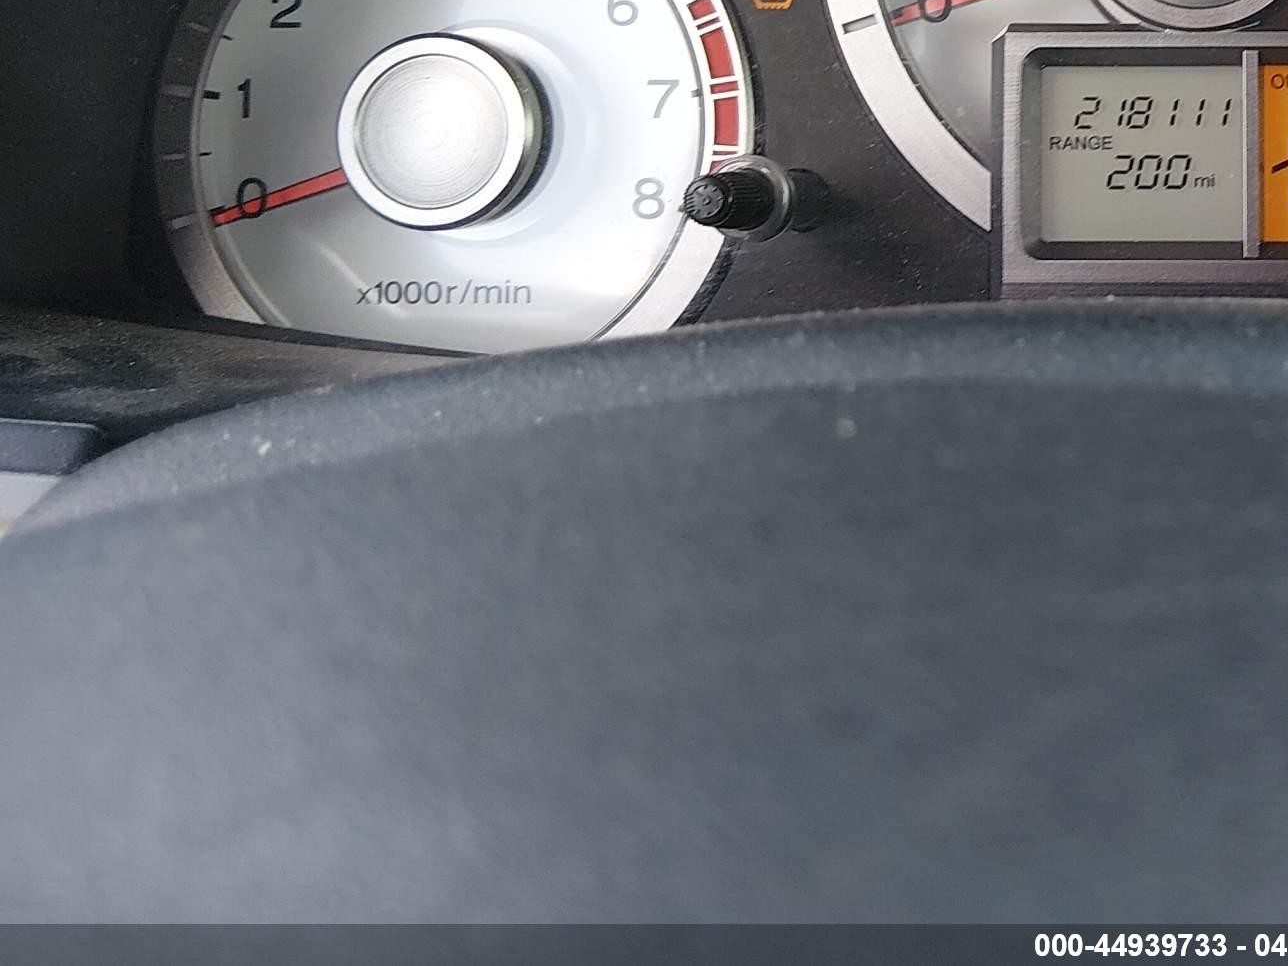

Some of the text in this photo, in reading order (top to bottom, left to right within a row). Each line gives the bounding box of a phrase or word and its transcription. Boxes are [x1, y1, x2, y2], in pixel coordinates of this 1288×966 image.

[237, 79, 252, 118] 1
[647, 79, 679, 118] 7
[1074, 96, 1232, 129] 218111
[1049, 135, 1113, 151] RANGE
[1107, 153, 1216, 190] 200 mi
[237, 177, 267, 219] 0
[632, 178, 664, 219] 8
[356, 279, 532, 306] x1000r/min
